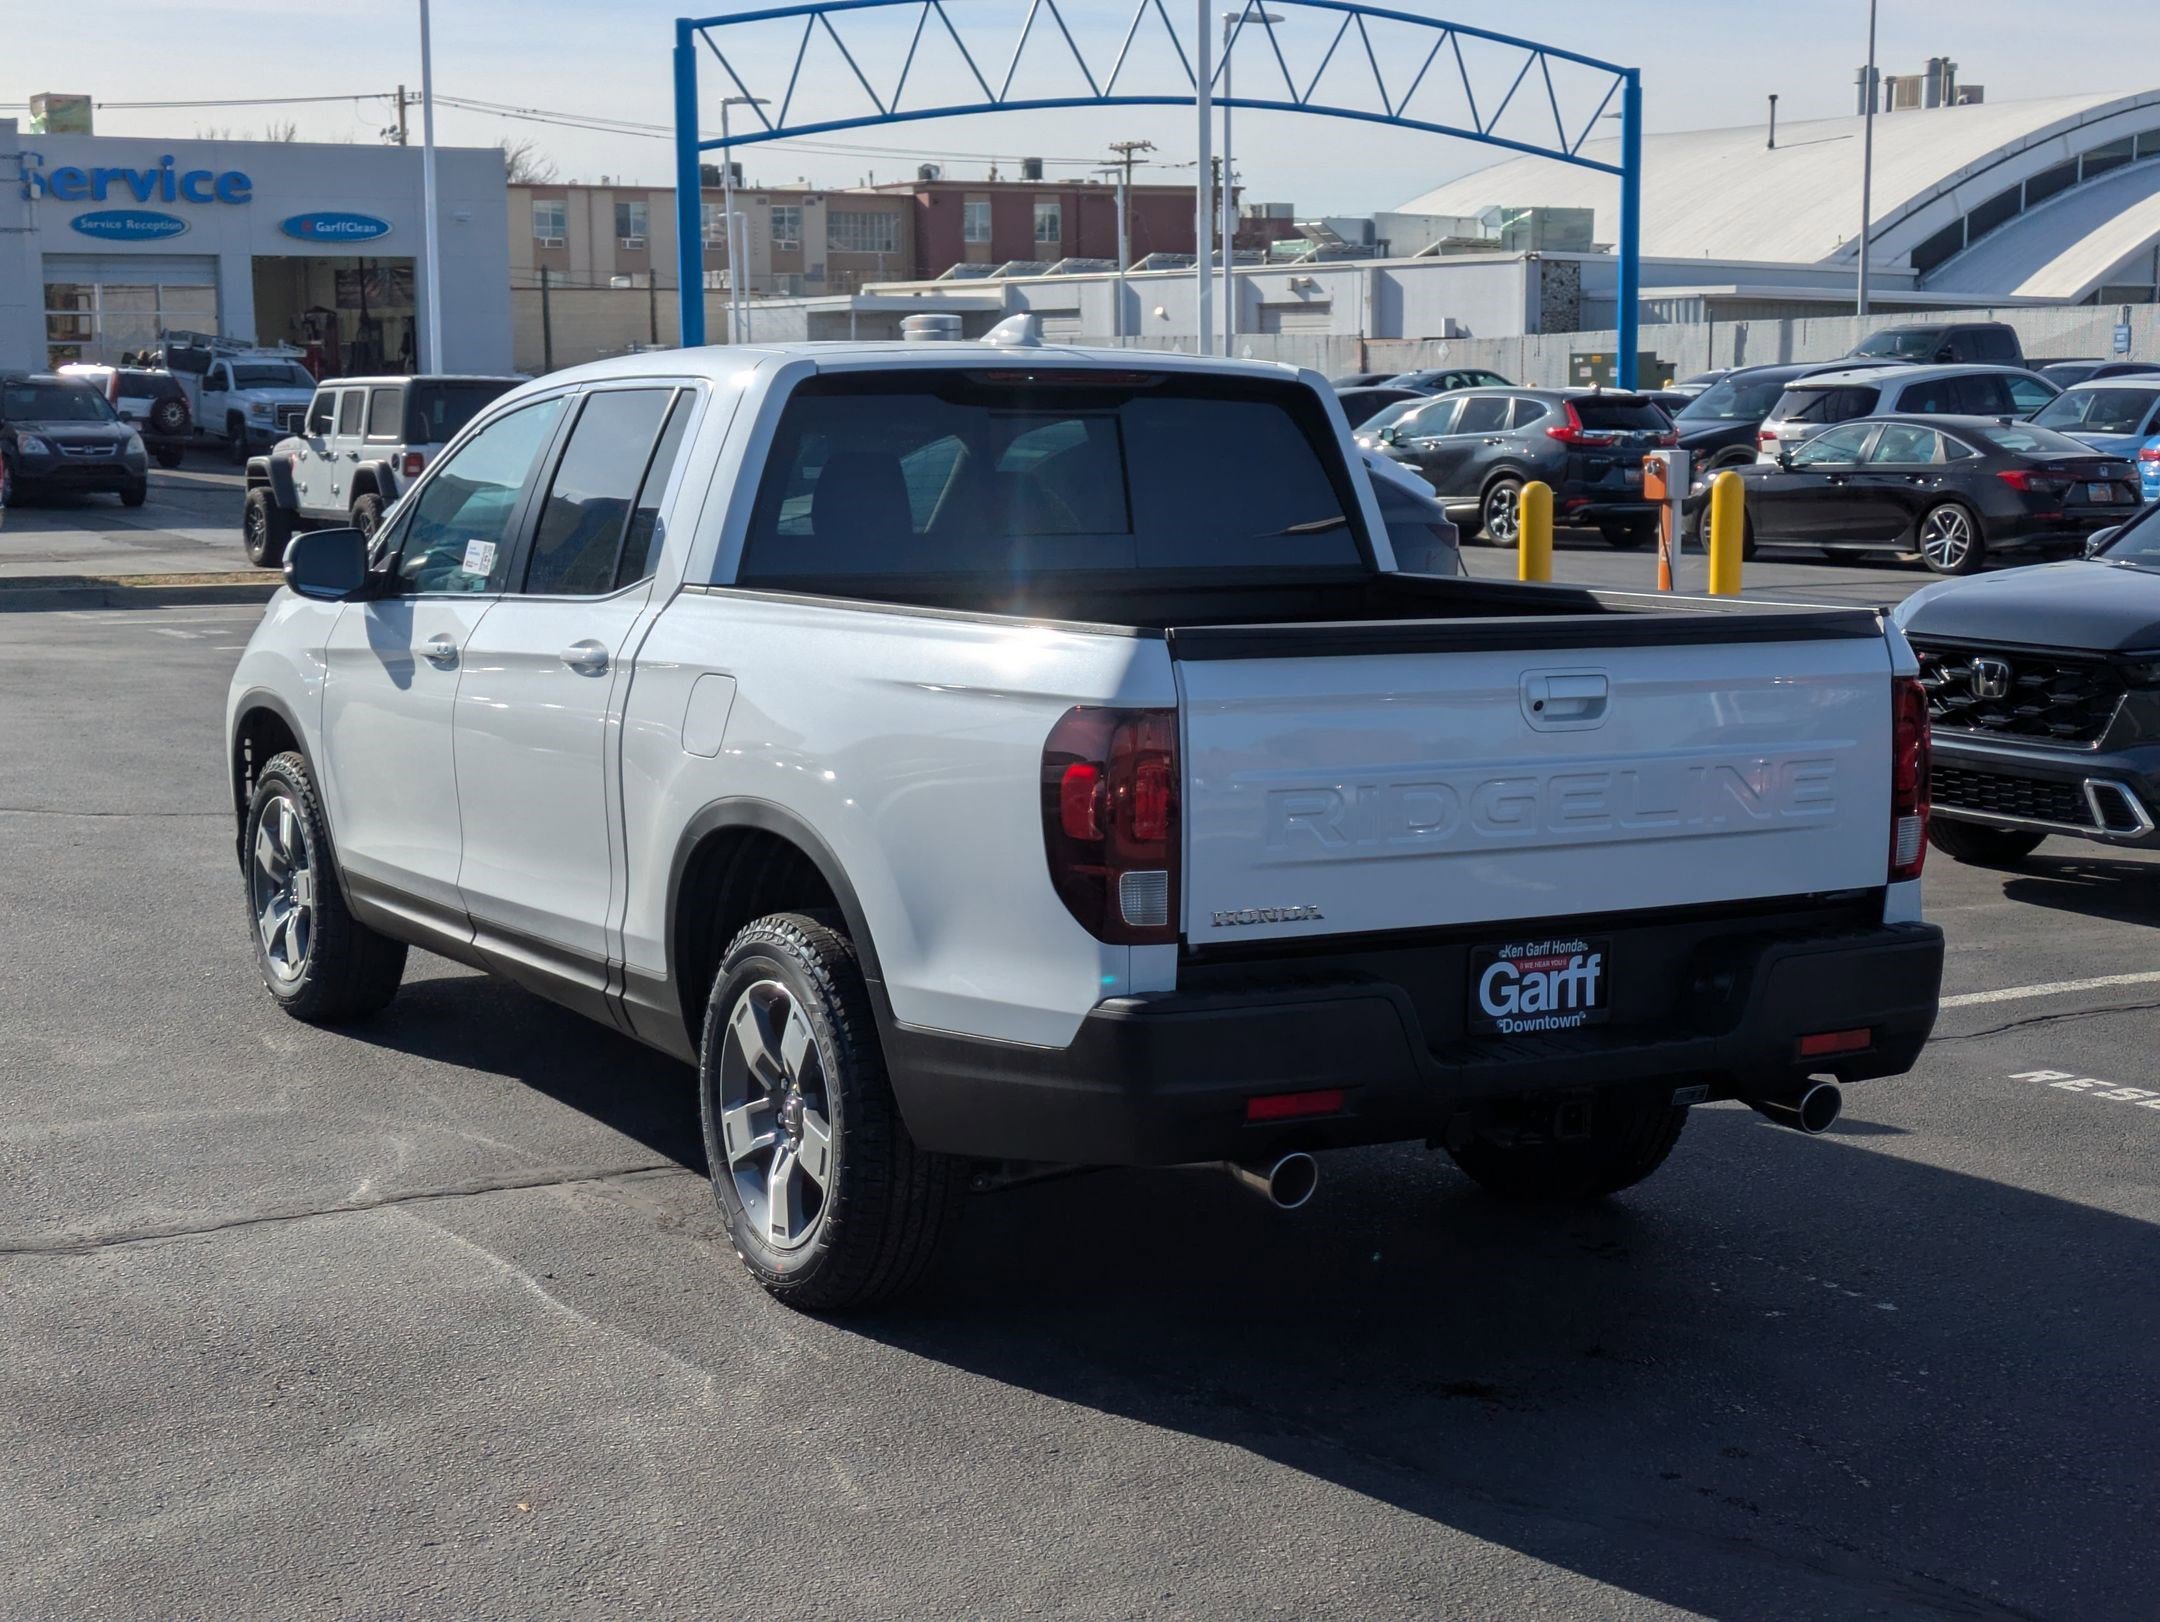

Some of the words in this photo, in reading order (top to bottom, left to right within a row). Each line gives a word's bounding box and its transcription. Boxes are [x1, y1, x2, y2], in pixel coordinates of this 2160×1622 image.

[20, 151, 253, 204] Service
[80, 217, 122, 230] Service
[126, 219, 183, 233] Reception
[315, 221, 377, 233] GarffClean
[1267, 757, 1837, 852] RIDGELINE
[1210, 904, 1325, 927] HONDA
[1504, 944, 1523, 958] Ken
[1526, 941, 1551, 957] Garff
[1552, 938, 1583, 955] Honda
[1480, 953, 1602, 1017] Garff
[1502, 1014, 1581, 1034] Downtown
